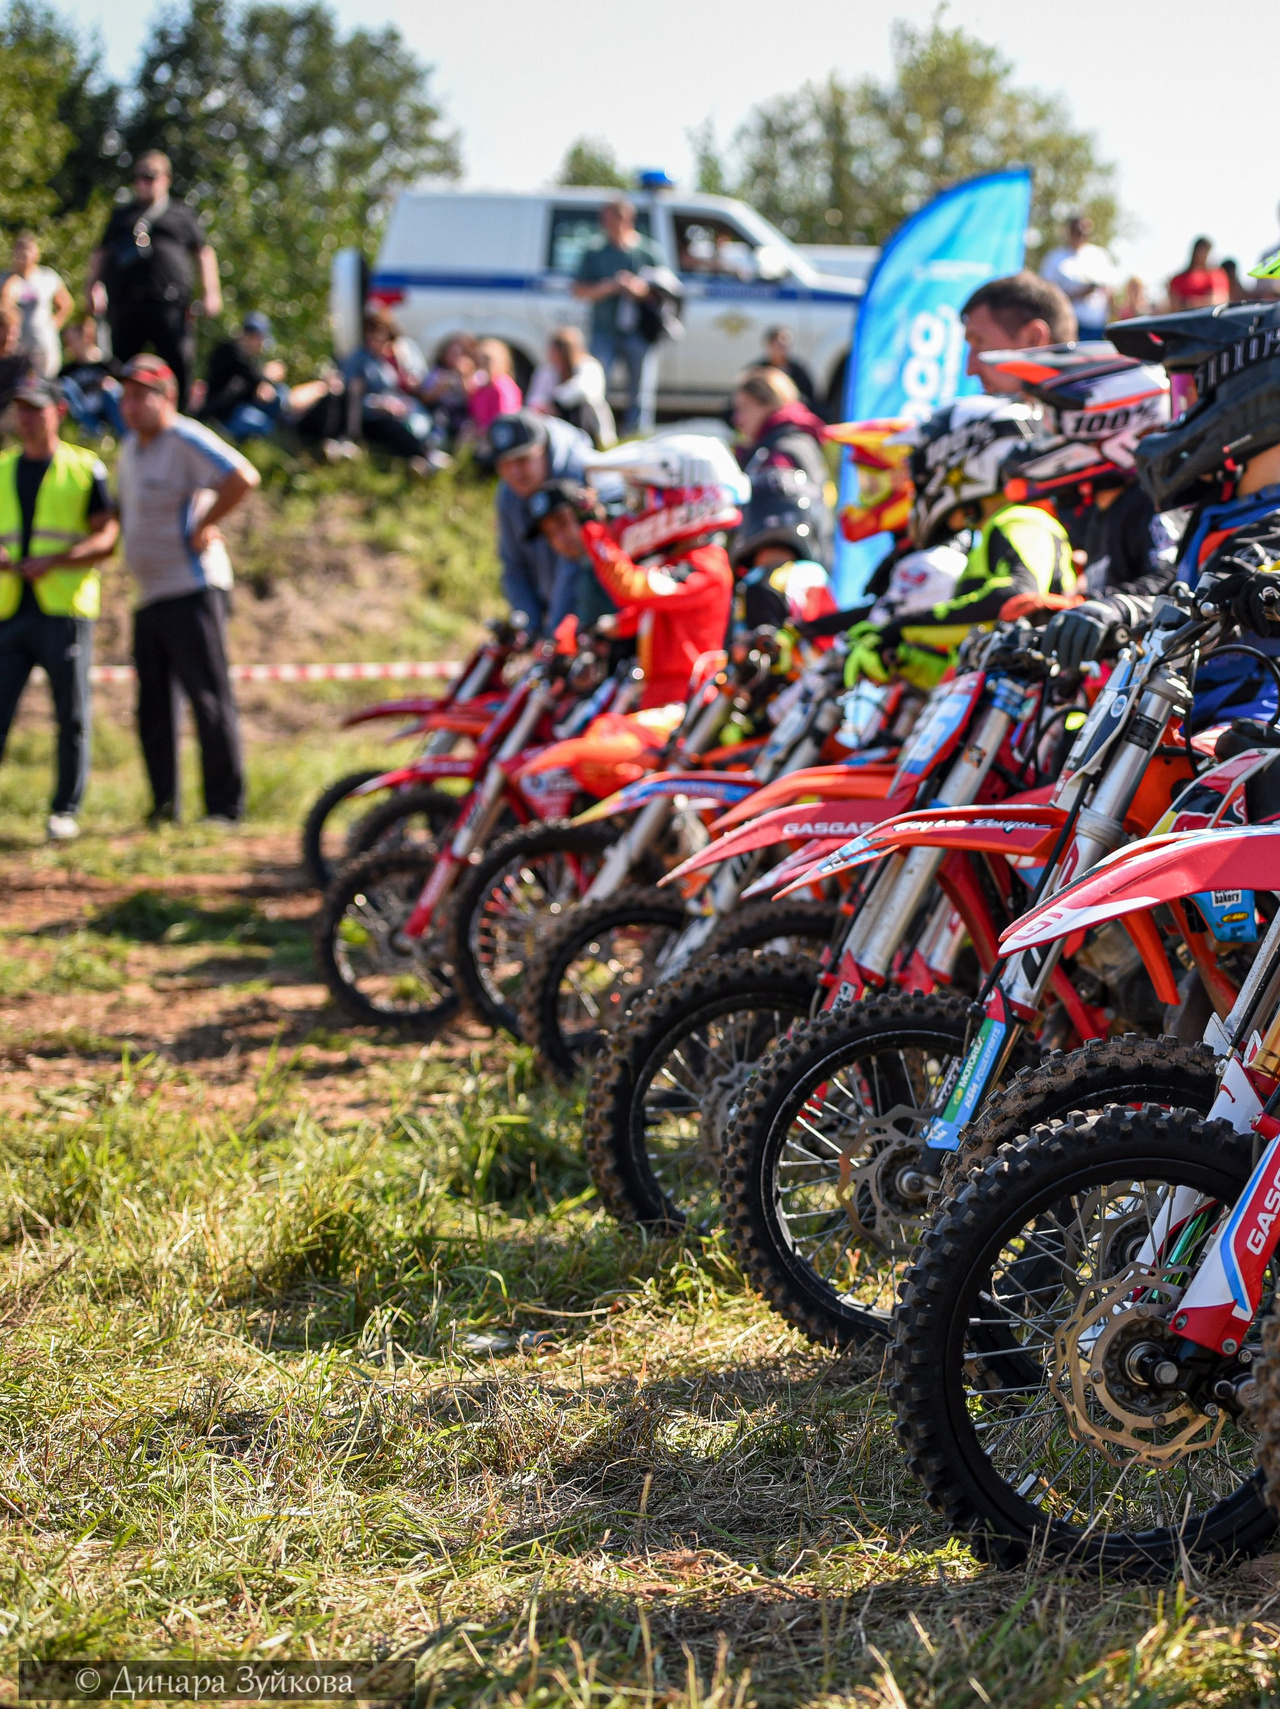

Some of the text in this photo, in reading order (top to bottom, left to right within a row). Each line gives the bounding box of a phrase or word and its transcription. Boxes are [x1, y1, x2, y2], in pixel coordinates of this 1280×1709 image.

[1071, 402, 1161, 434] 100%
[783, 821, 875, 835] GASGAS
[958, 1036, 985, 1089] MOTOREX
